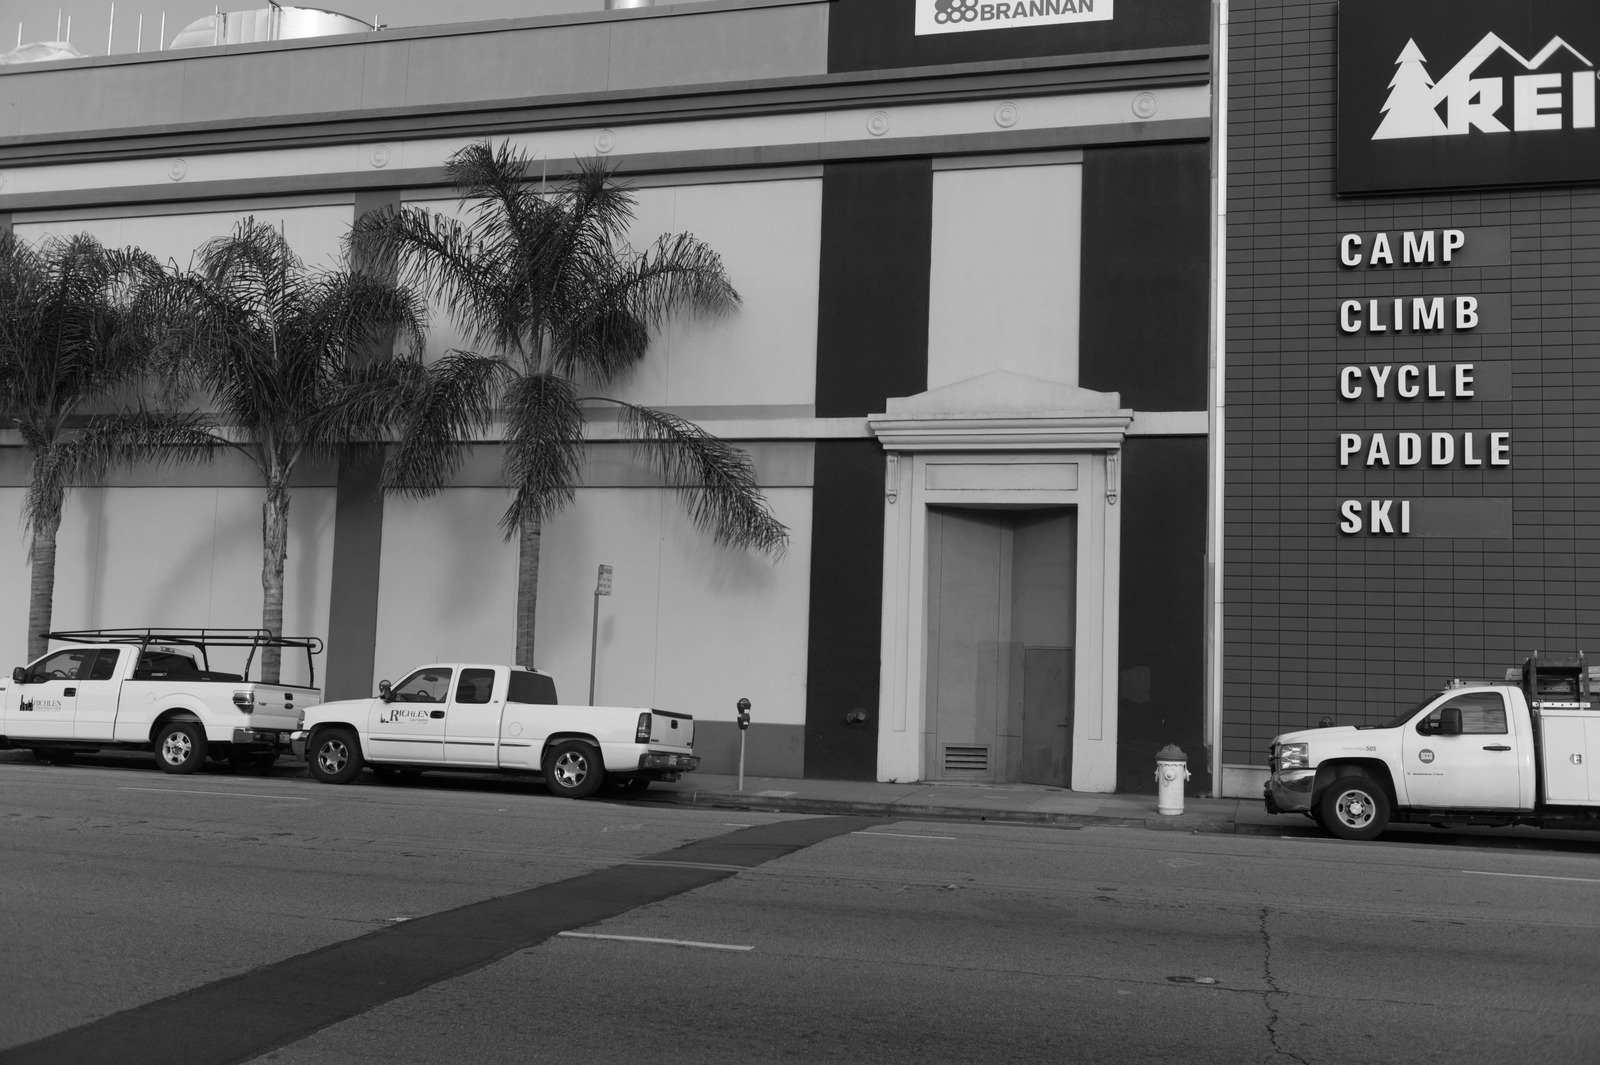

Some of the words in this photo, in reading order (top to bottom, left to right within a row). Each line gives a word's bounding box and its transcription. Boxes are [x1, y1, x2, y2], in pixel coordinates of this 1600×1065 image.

[980, 0, 1094, 22] BRANNAN
[1446, 70, 1596, 136] REI
[1340, 229, 1466, 266] CAMP
[1340, 296, 1479, 333] CLIMB
[1340, 363, 1475, 399] CYCLE
[1340, 431, 1511, 467] PADDLE
[1340, 499, 1411, 534] SKI
